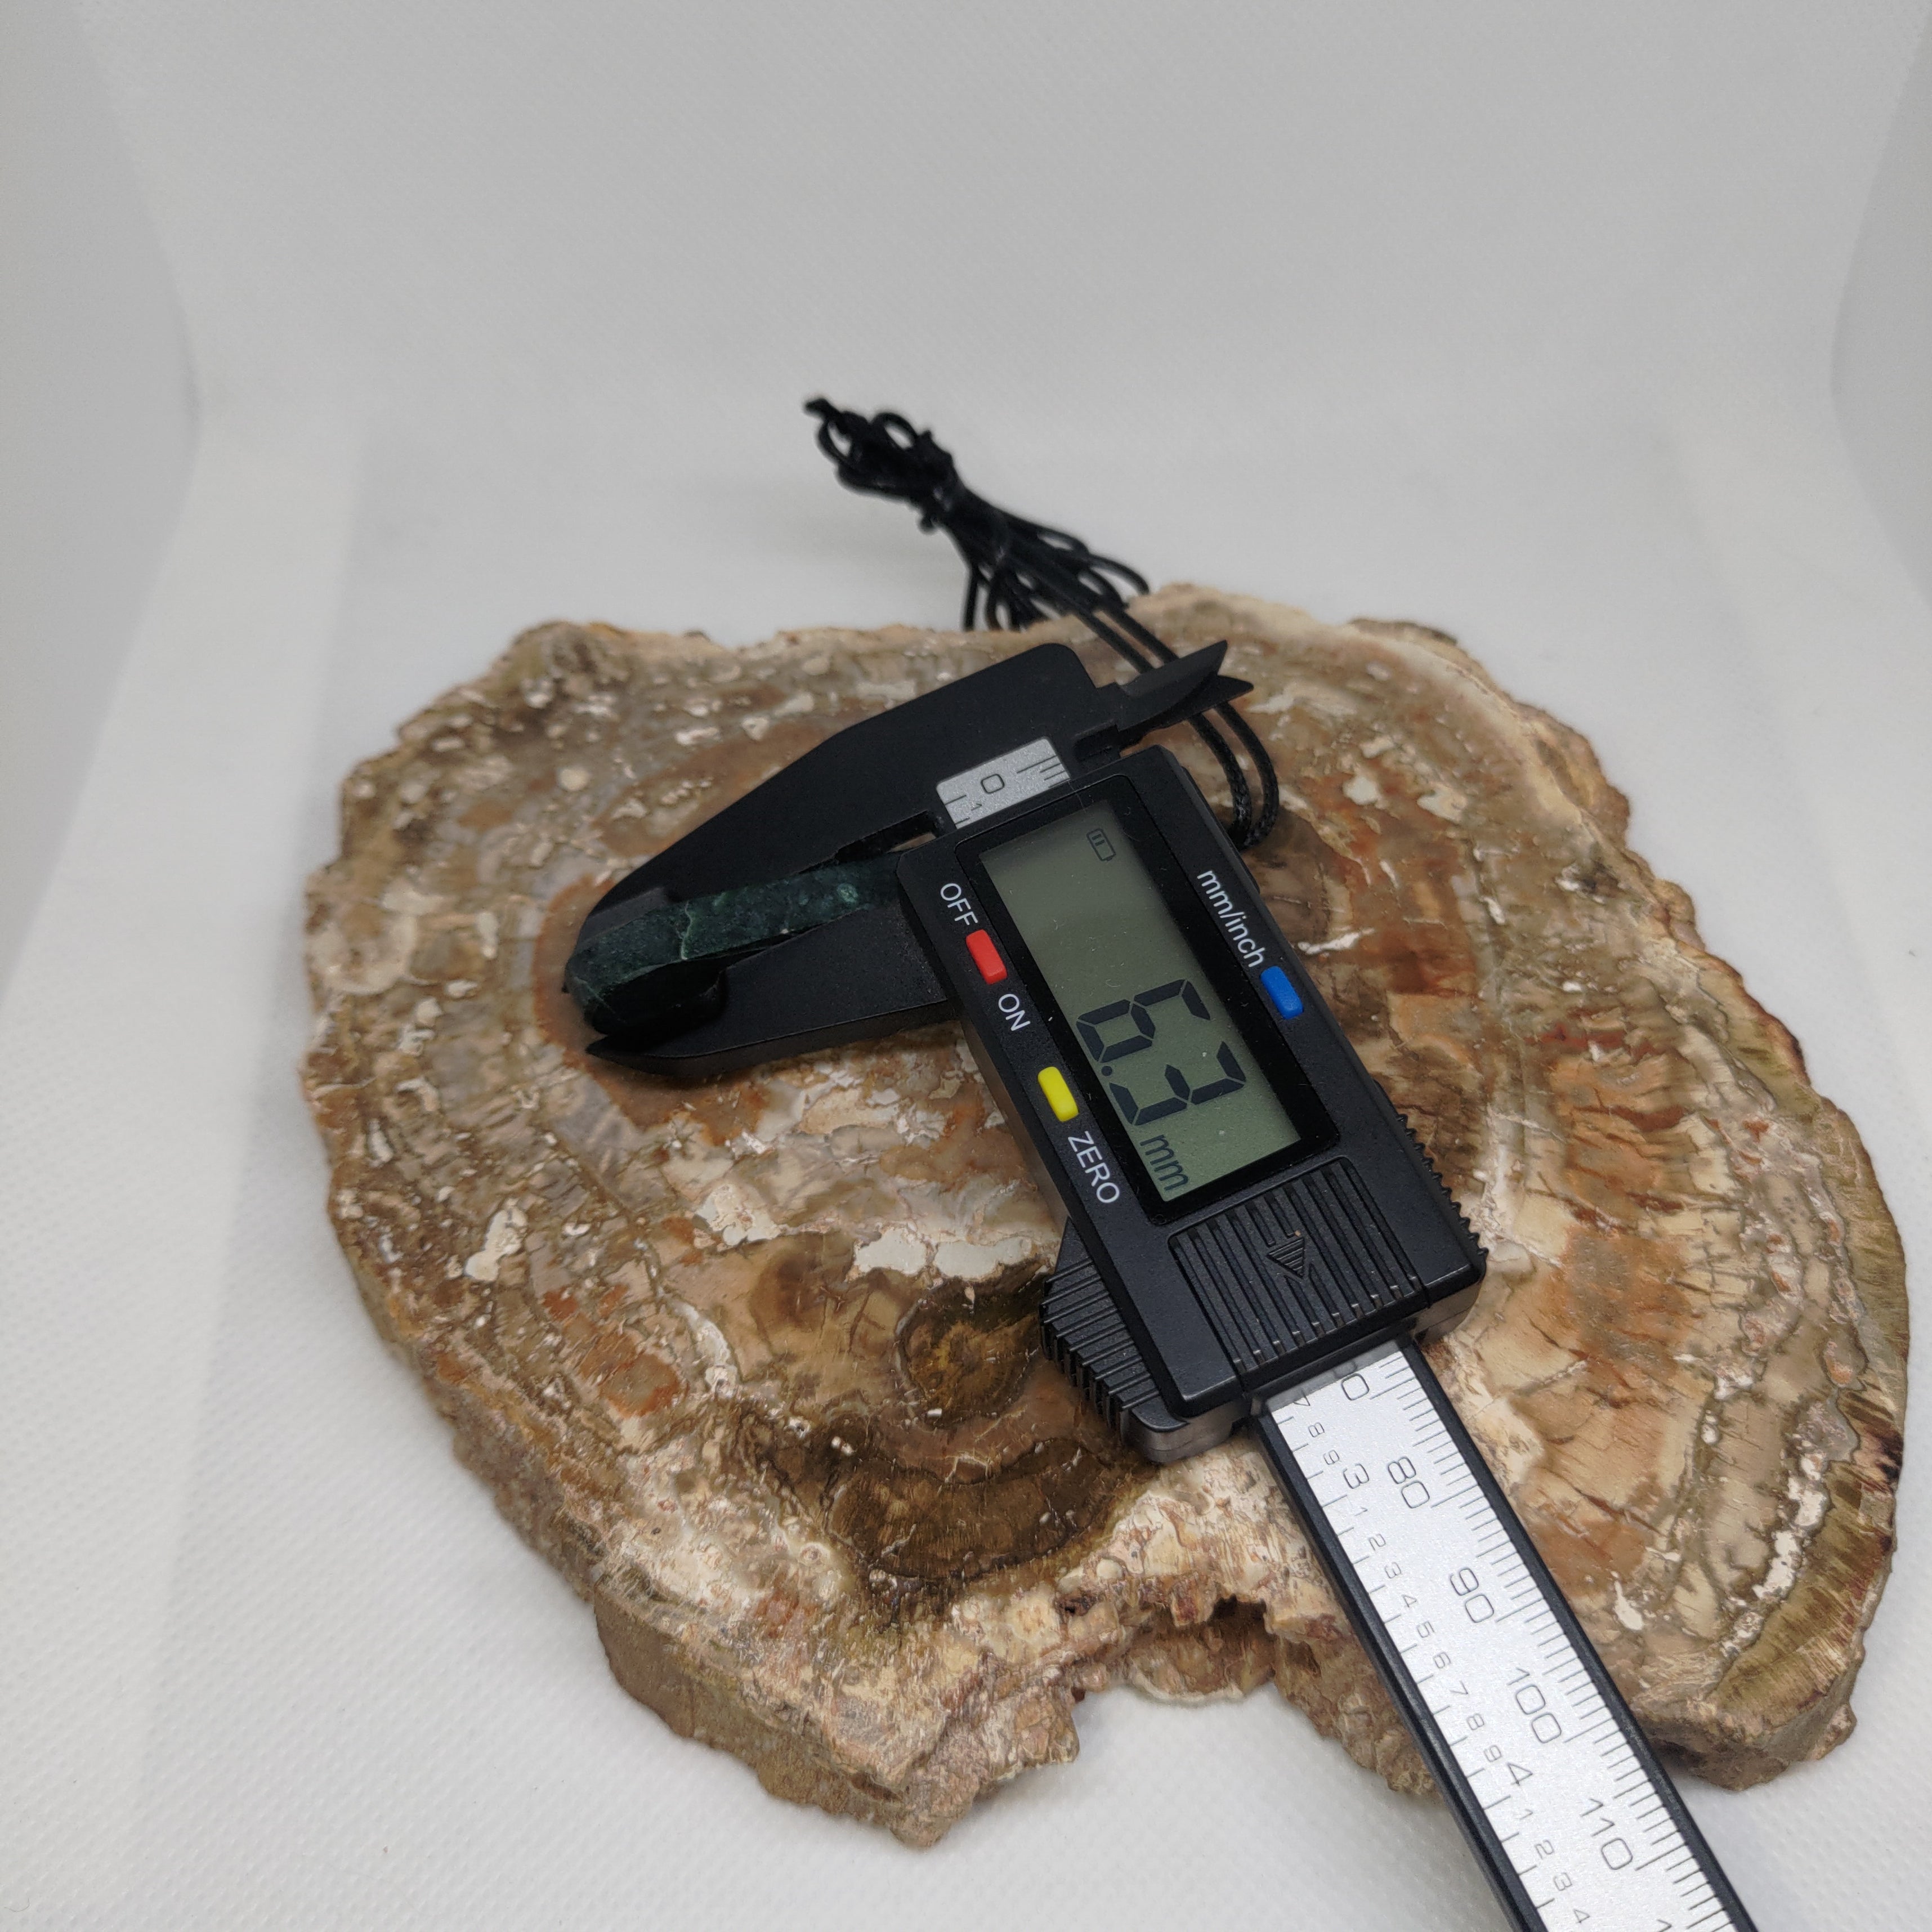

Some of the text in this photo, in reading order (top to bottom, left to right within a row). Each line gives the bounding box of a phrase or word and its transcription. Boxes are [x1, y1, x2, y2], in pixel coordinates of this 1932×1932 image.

[981, 773, 1005, 794] 0
[940, 883, 979, 926] OFF
[1197, 870, 1265, 968] mm/inch
[998, 994, 1031, 1032] ON
[1076, 978, 1246, 1192] 6.3 mm
[1067, 1130, 1120, 1204] ZERO
[1323, 1449, 1340, 1466] 9
[1343, 1463, 1370, 1490] 3
[1354, 1506, 1368, 1517] 1
[1368, 1533, 1387, 1551] 2
[1384, 1562, 1402, 1580] 3
[1402, 1594, 1417, 1608] 4
[1416, 1620, 1435, 1639] 5
[1387, 1455, 1430, 1509] 80
[1450, 1567, 1495, 1624] 90
[1506, 1667, 1562, 1744] 100
[1580, 1797, 1634, 1871] 110
[1433, 1651, 1452, 1669] 6
[1450, 1680, 1469, 1696] 7
[1466, 1713, 1485, 1731] 8
[1483, 1745, 1503, 1763] 9
[1506, 1762, 1533, 1787] 4
[1518, 1808, 1534, 1821] 1
[1535, 1839, 1555, 1859] 2
[1553, 1872, 1573, 1891] 3
[1573, 1908, 1591, 1925] 4
